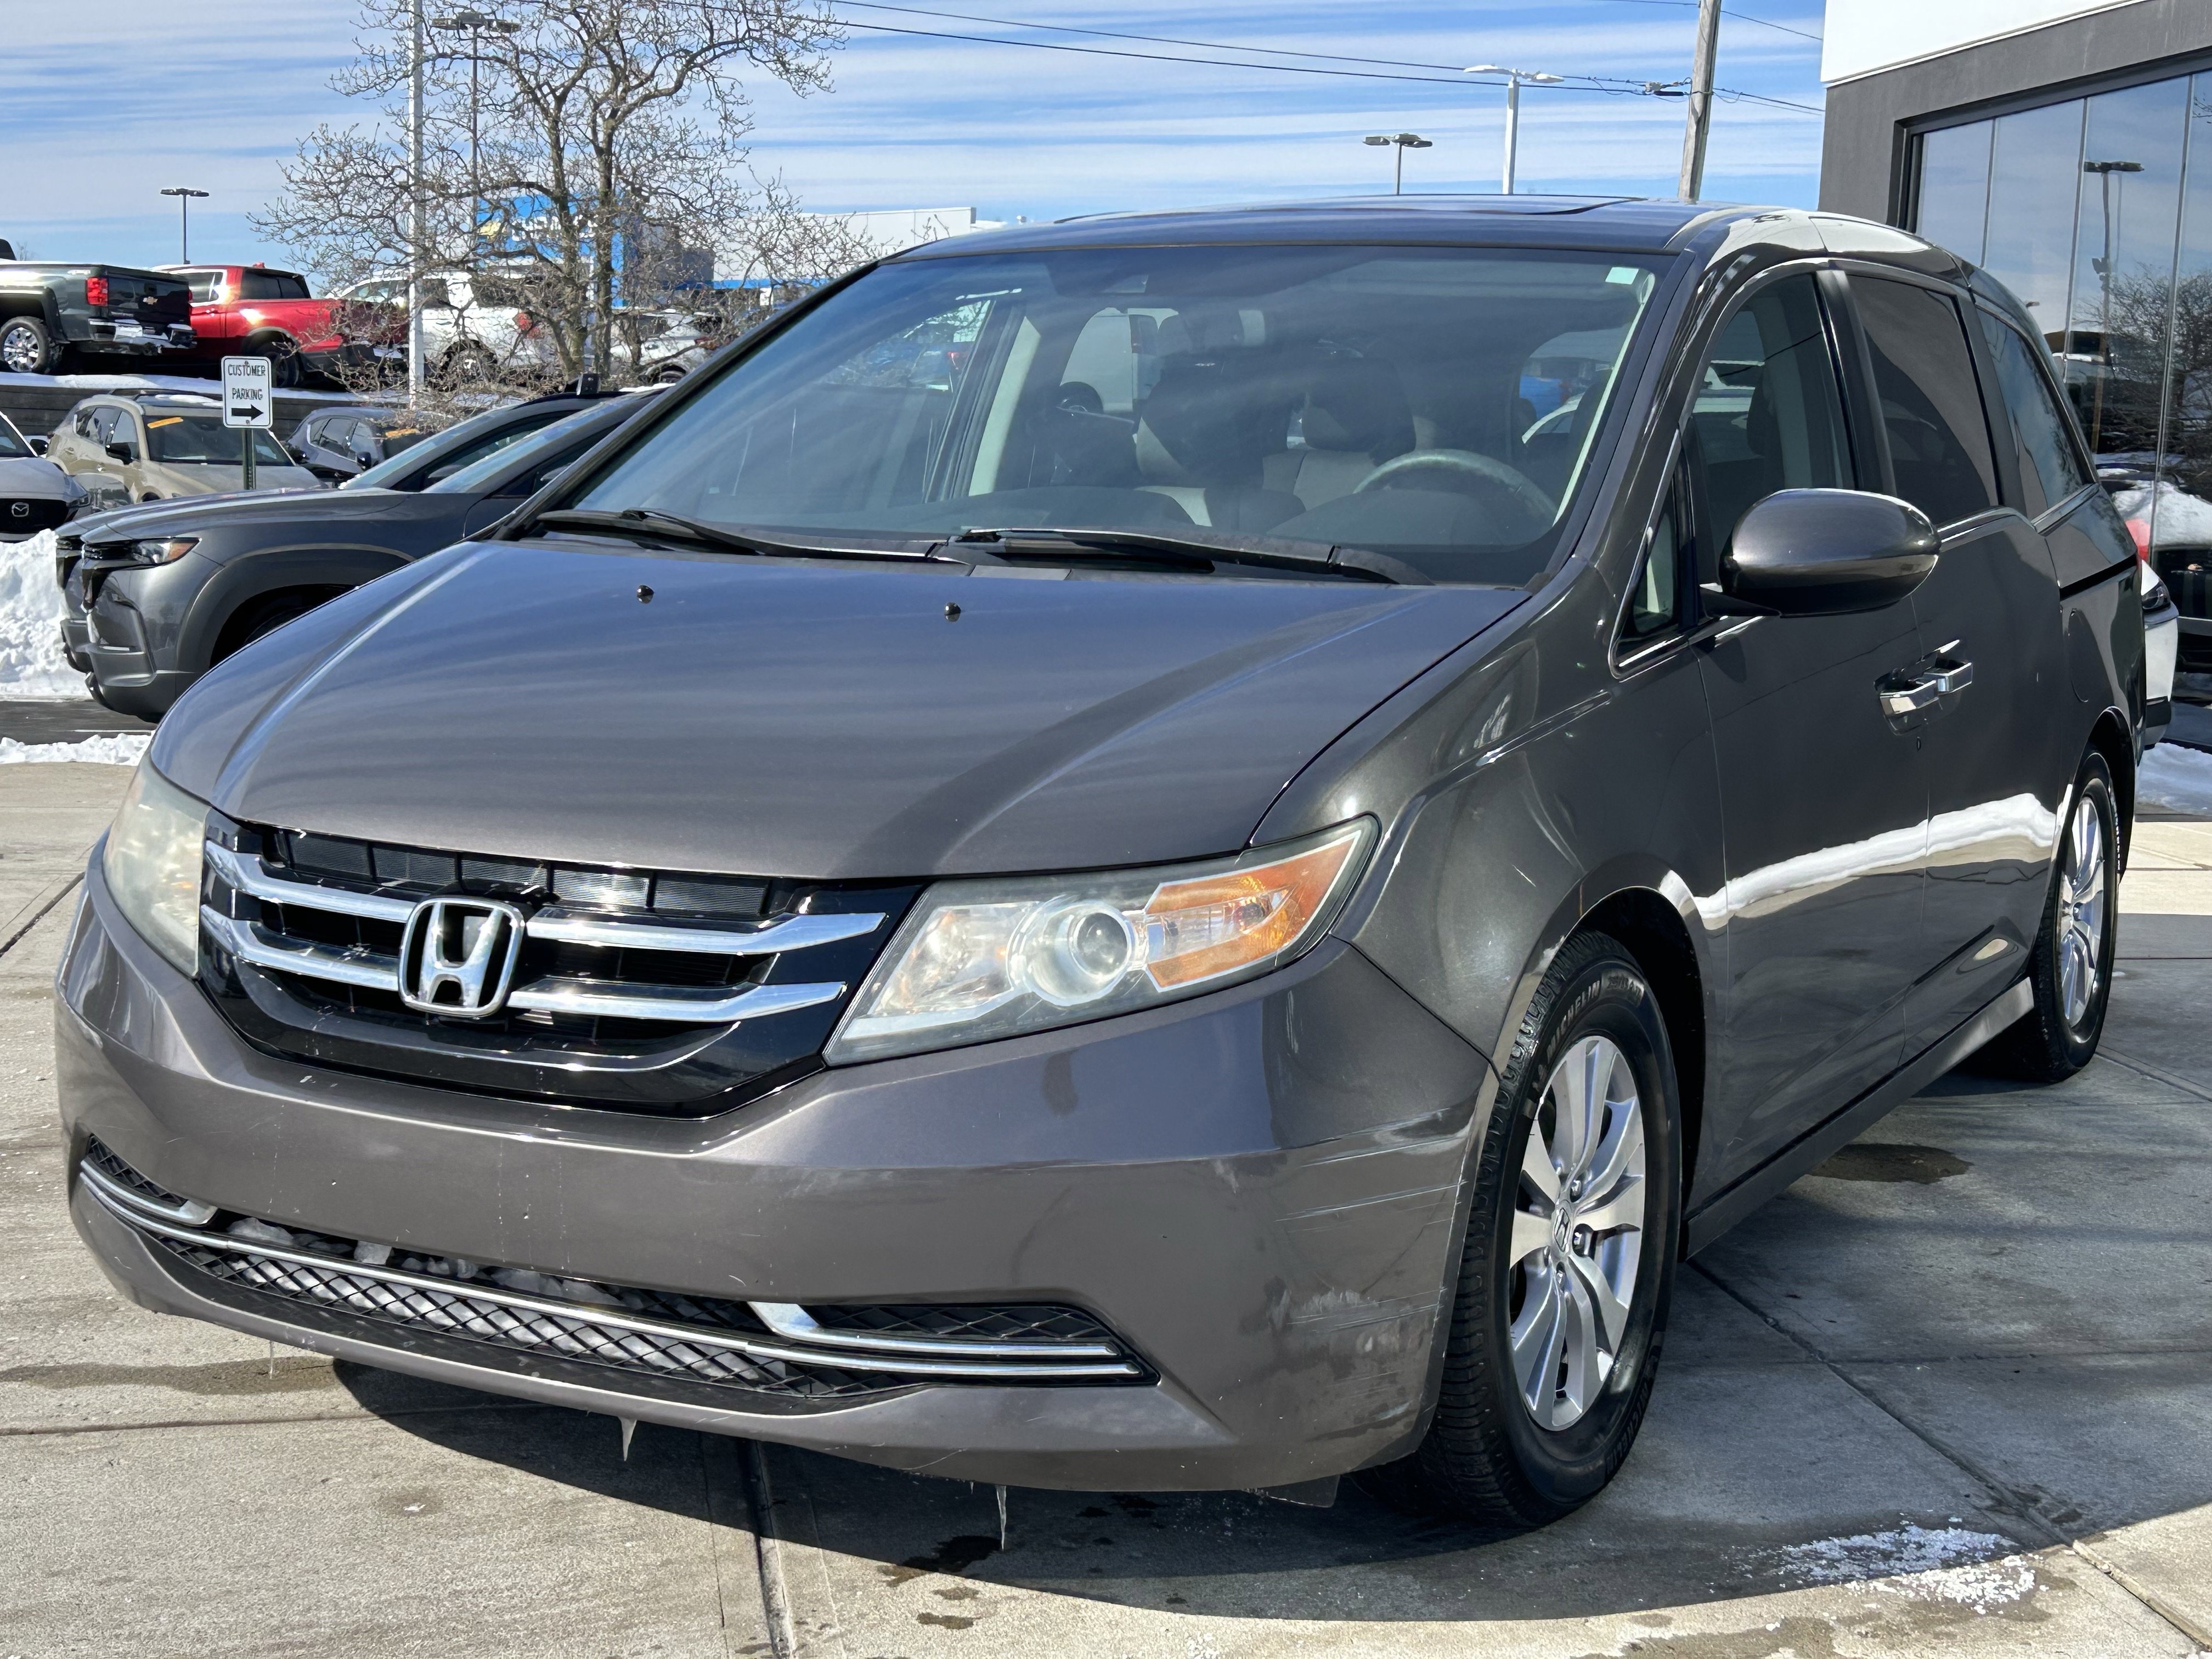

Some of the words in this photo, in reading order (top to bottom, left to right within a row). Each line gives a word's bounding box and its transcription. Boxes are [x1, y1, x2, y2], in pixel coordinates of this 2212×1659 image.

[228, 364, 266, 376] CUSTOMER
[232, 387, 263, 400] PARKING
[1547, 980, 1600, 1064] MICHELIN
